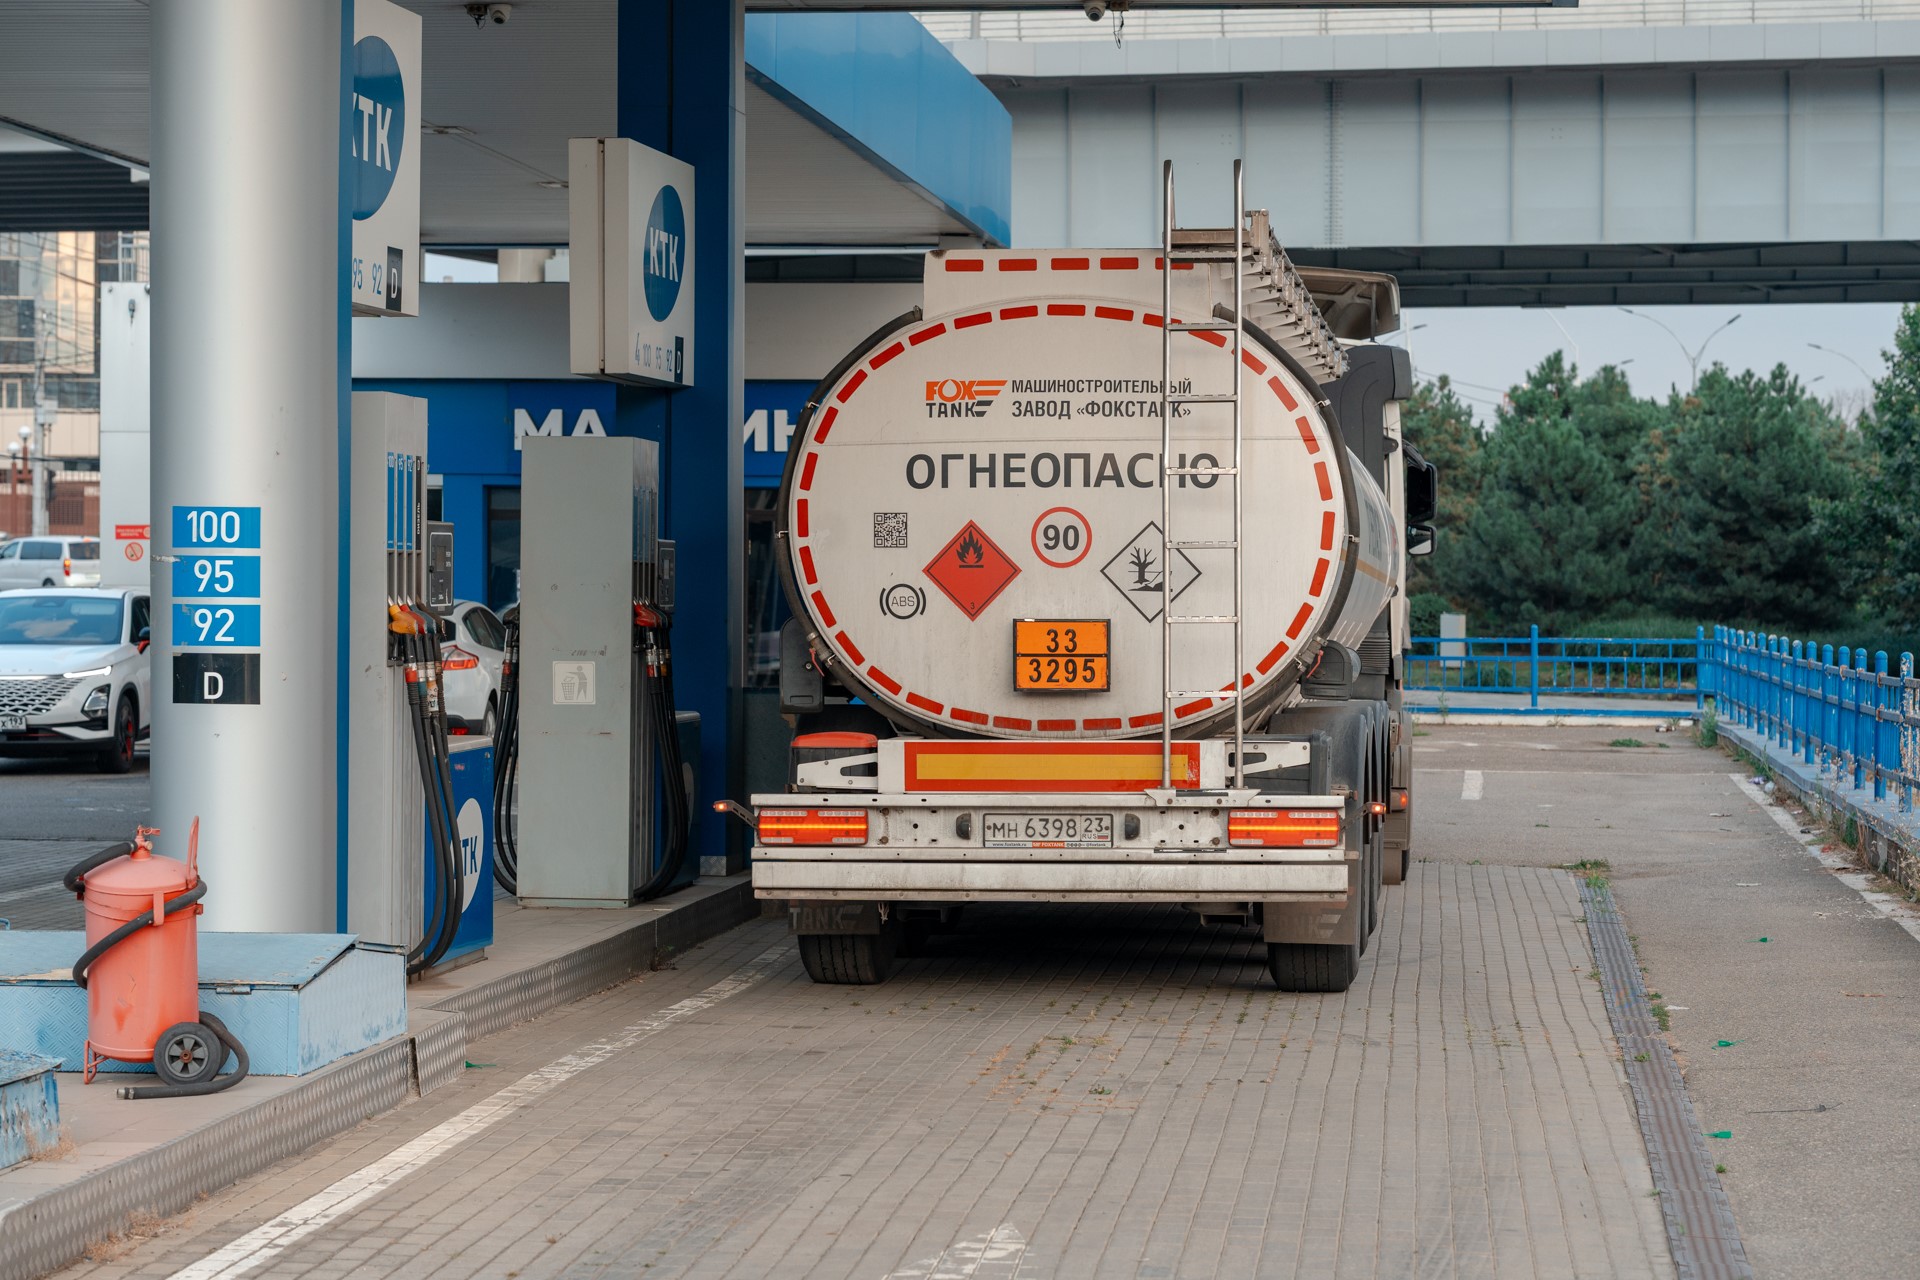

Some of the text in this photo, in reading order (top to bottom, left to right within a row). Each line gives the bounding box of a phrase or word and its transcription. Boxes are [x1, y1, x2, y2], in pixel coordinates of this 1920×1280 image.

[650, 227, 679, 282] КТК
[353, 258, 398, 299] 95 92 D
[667, 349, 672, 372] 92
[677, 350, 682, 374] D
[926, 379, 980, 402] FOX
[926, 402, 977, 418] TANK
[1012, 401, 1071, 419] ЗАВОД
[187, 510, 240, 543] 100
[1042, 524, 1080, 551] 90
[194, 559, 234, 593] 95
[891, 596, 915, 607] ABS
[970, 602, 975, 610] 3
[194, 608, 235, 642] 92
[1046, 628, 1078, 653] 33
[1028, 658, 1096, 683] 3295
[203, 671, 224, 700] D
[1025, 818, 1077, 838] 6398
[1084, 818, 1104, 832] 23
[454, 836, 478, 879] ТК
